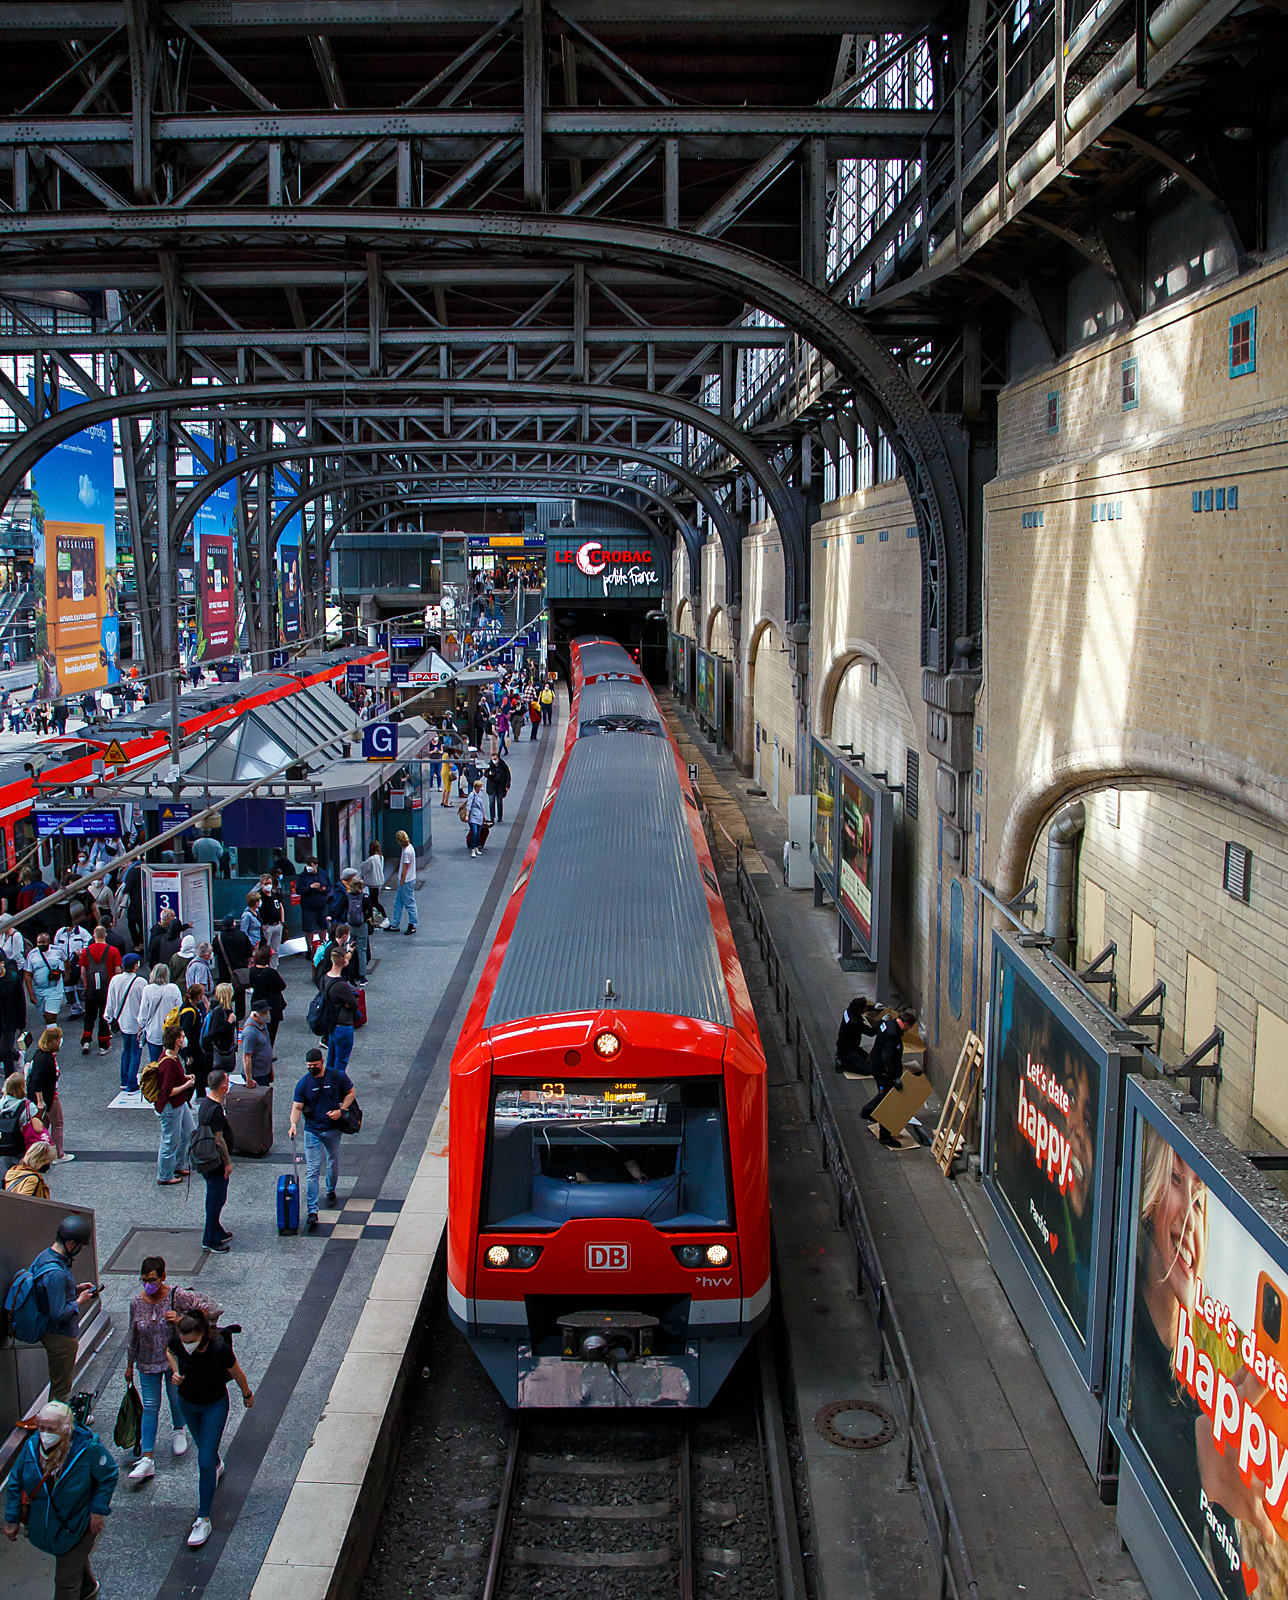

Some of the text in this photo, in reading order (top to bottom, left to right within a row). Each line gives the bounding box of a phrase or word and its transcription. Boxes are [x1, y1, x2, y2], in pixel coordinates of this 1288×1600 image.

[58, 540, 94, 549] NUSSKLASSE
[555, 550, 652, 563] LE CROBAG
[628, 565, 659, 587] France
[372, 725, 392, 752] G
[688, 765, 698, 779] H
[159, 894, 171, 910] 3
[1048, 1073, 1069, 1115] date
[1018, 1077, 1074, 1190] happy.
[1029, 1198, 1050, 1244] Parship
[590, 1247, 626, 1267] DB
[1241, 1329, 1288, 1405] date
[1199, 1487, 1241, 1572] Parship
